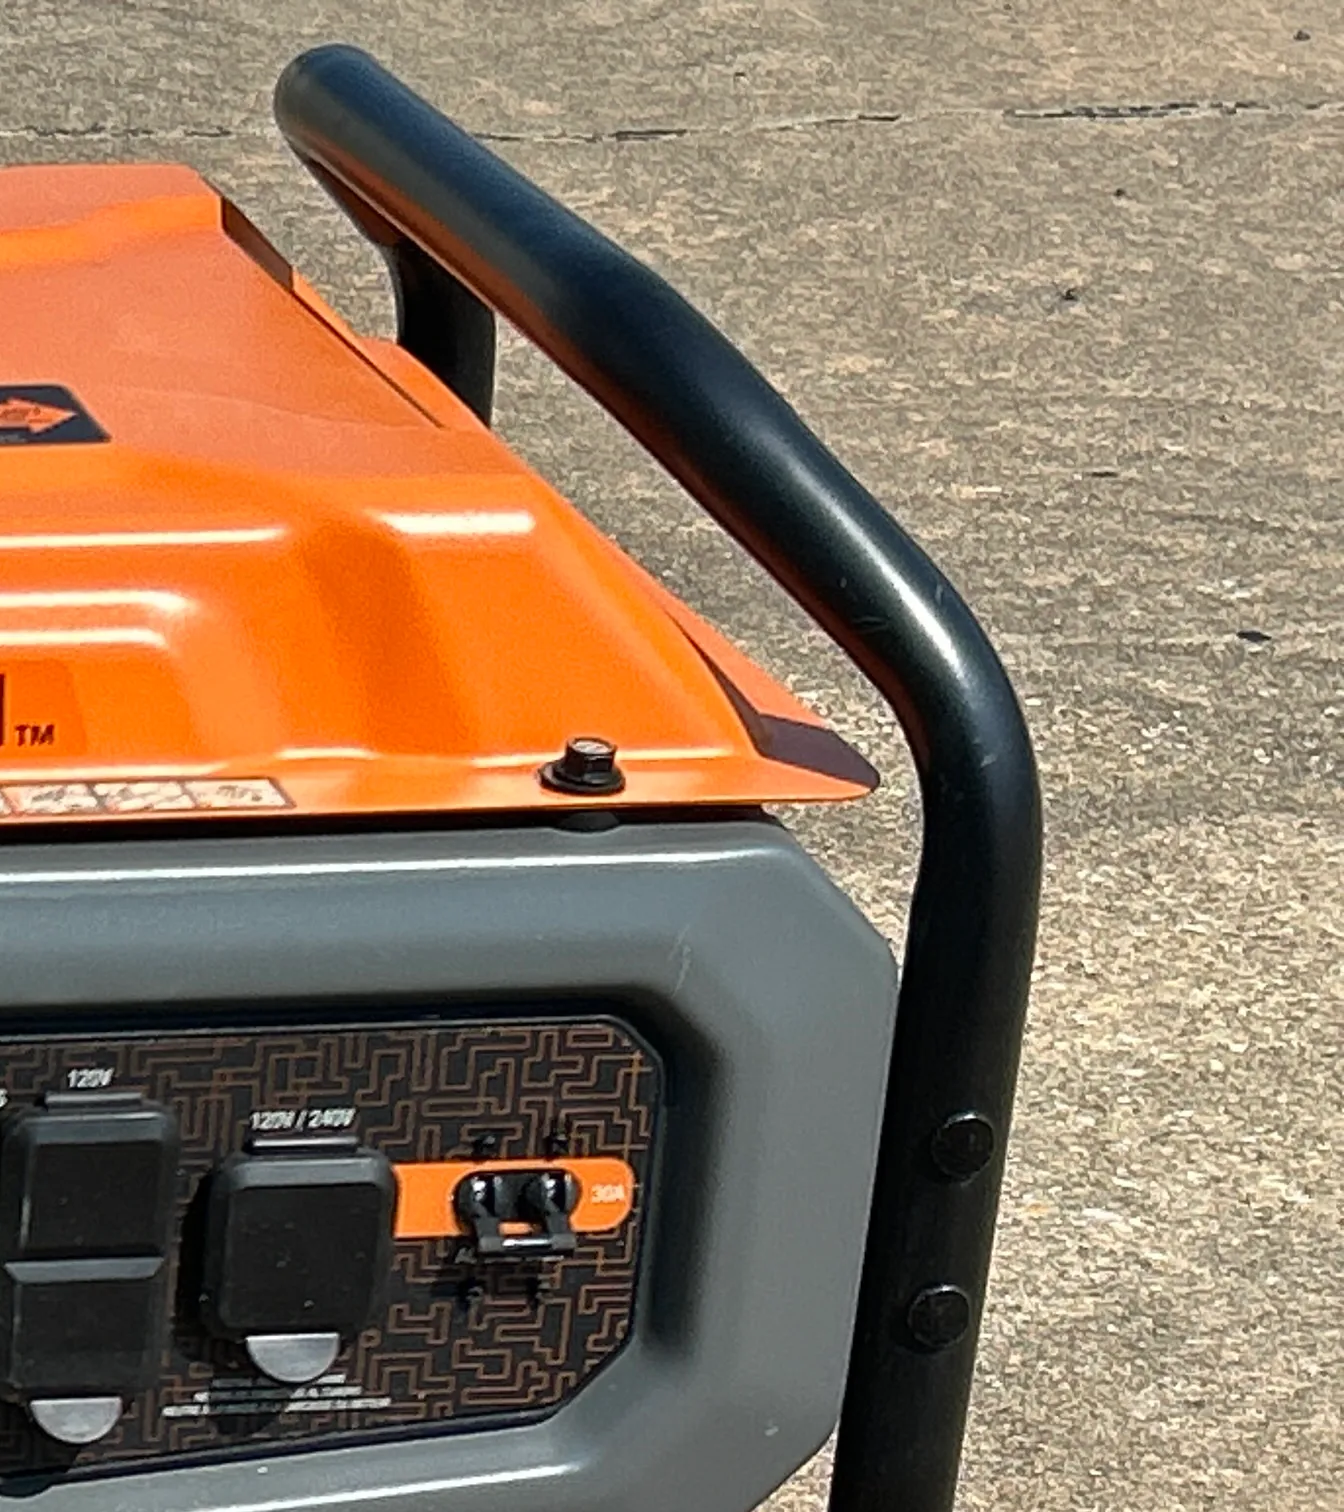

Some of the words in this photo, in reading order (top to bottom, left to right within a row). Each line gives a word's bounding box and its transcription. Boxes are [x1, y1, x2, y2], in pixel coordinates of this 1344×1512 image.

[67, 1067, 115, 1088] 120V
[250, 1110, 295, 1131] 120V
[591, 1184, 625, 1204] 30A
